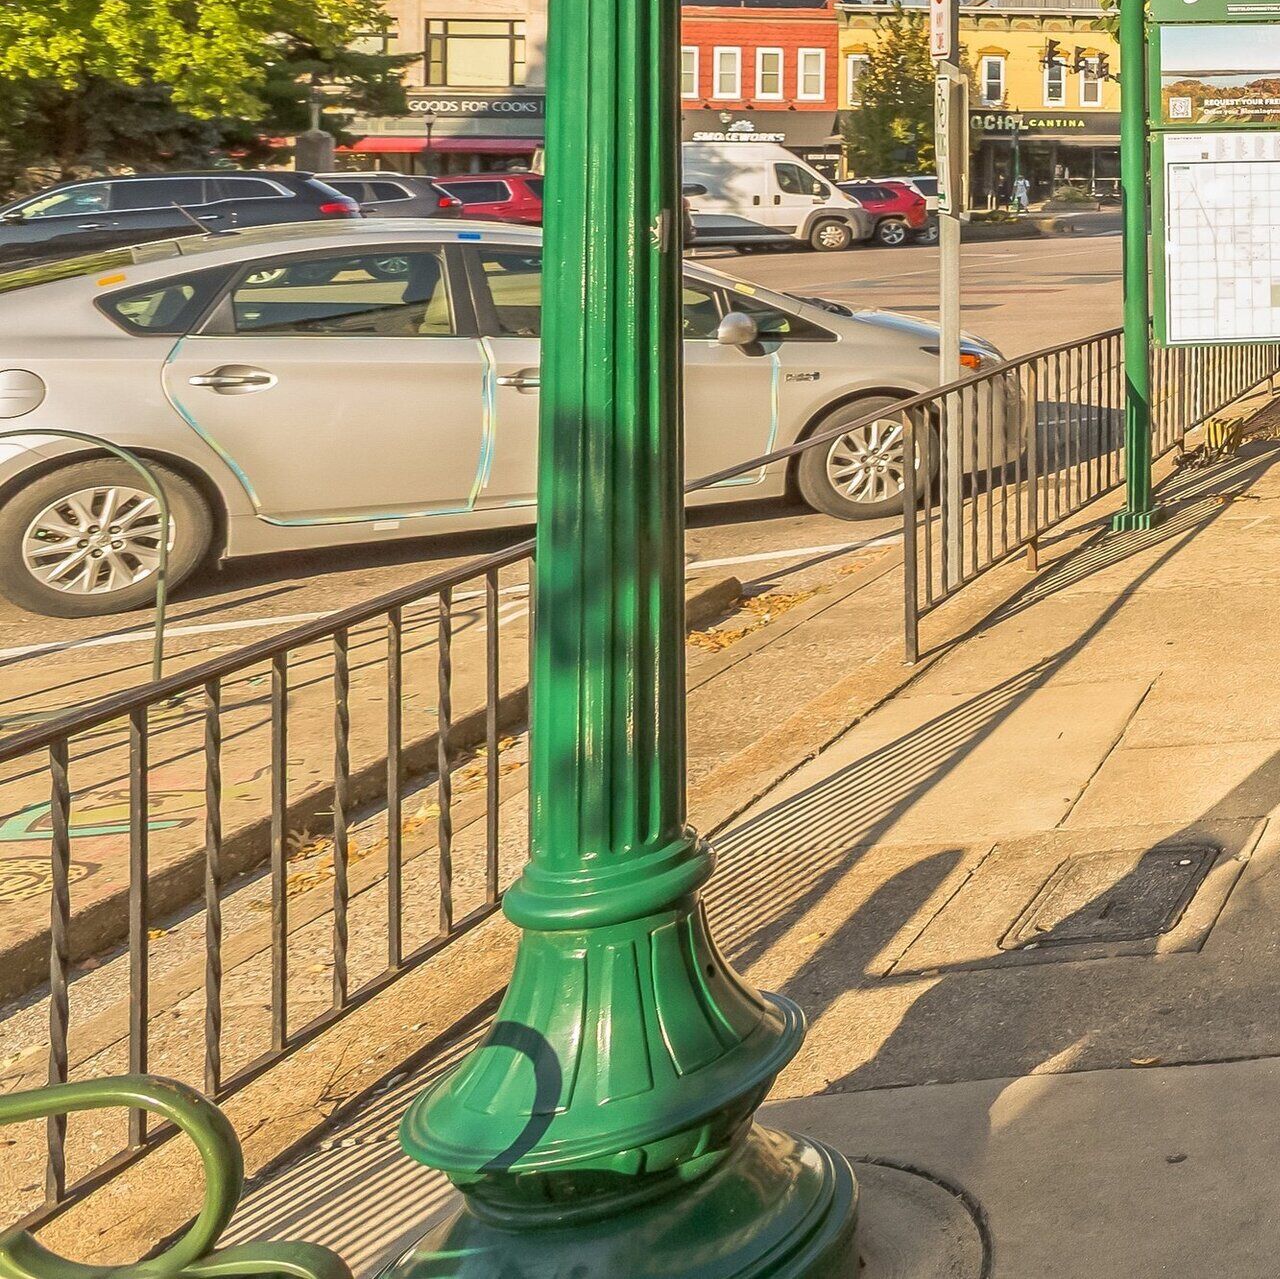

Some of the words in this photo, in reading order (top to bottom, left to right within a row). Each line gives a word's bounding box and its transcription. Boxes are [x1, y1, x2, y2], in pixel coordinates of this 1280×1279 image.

[408, 100, 459, 112] GOODS
[461, 101, 489, 112] FOR
[492, 101, 538, 112] COOKS
[1204, 98, 1240, 106] REQUEST
[970, 114, 1029, 130] OCIAL
[1029, 119, 1086, 128] CANTINA
[692, 131, 786, 143] SMOKEWORKS
